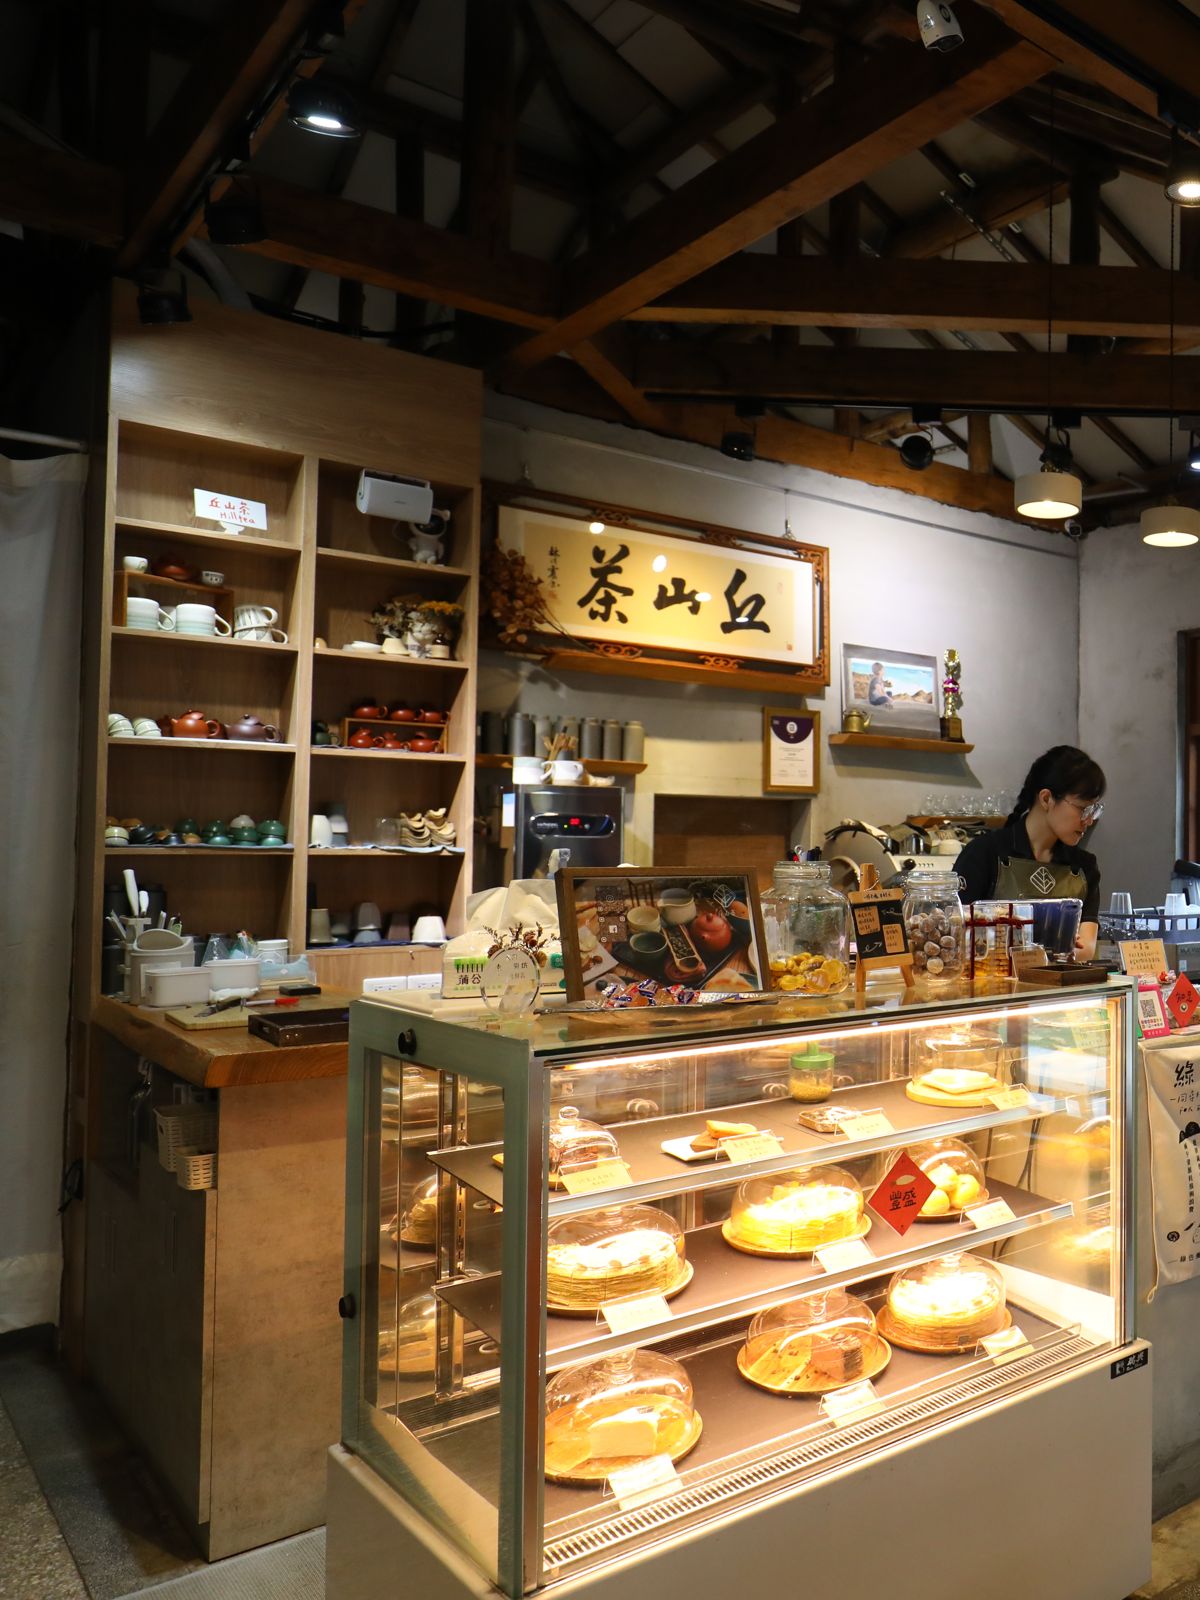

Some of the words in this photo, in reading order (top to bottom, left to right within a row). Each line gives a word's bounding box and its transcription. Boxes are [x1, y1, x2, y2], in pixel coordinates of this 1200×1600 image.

[208, 496, 250, 515] 丘山茶
[888, 1187, 917, 1212] 豐盛
